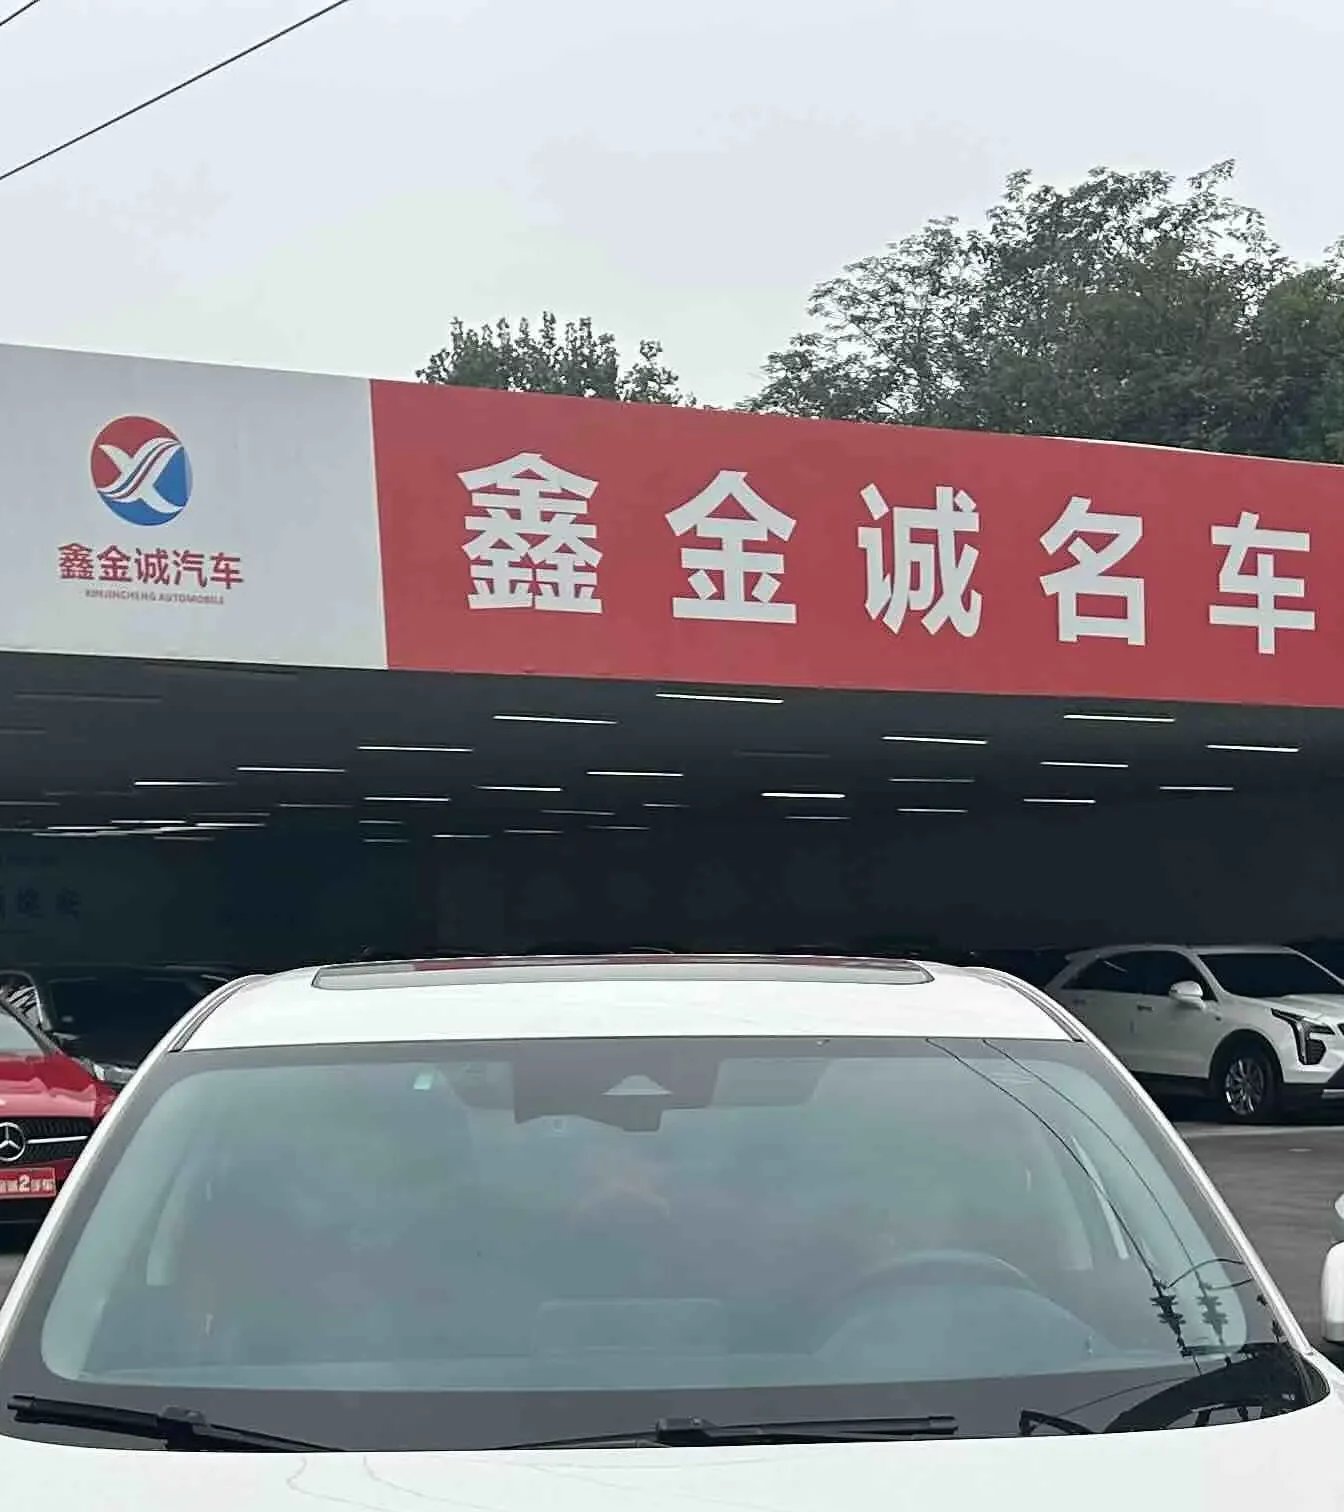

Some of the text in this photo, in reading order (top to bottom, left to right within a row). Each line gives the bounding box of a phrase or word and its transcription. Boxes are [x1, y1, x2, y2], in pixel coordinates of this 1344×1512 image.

[58, 543, 244, 590] 鑫金诚汽车
